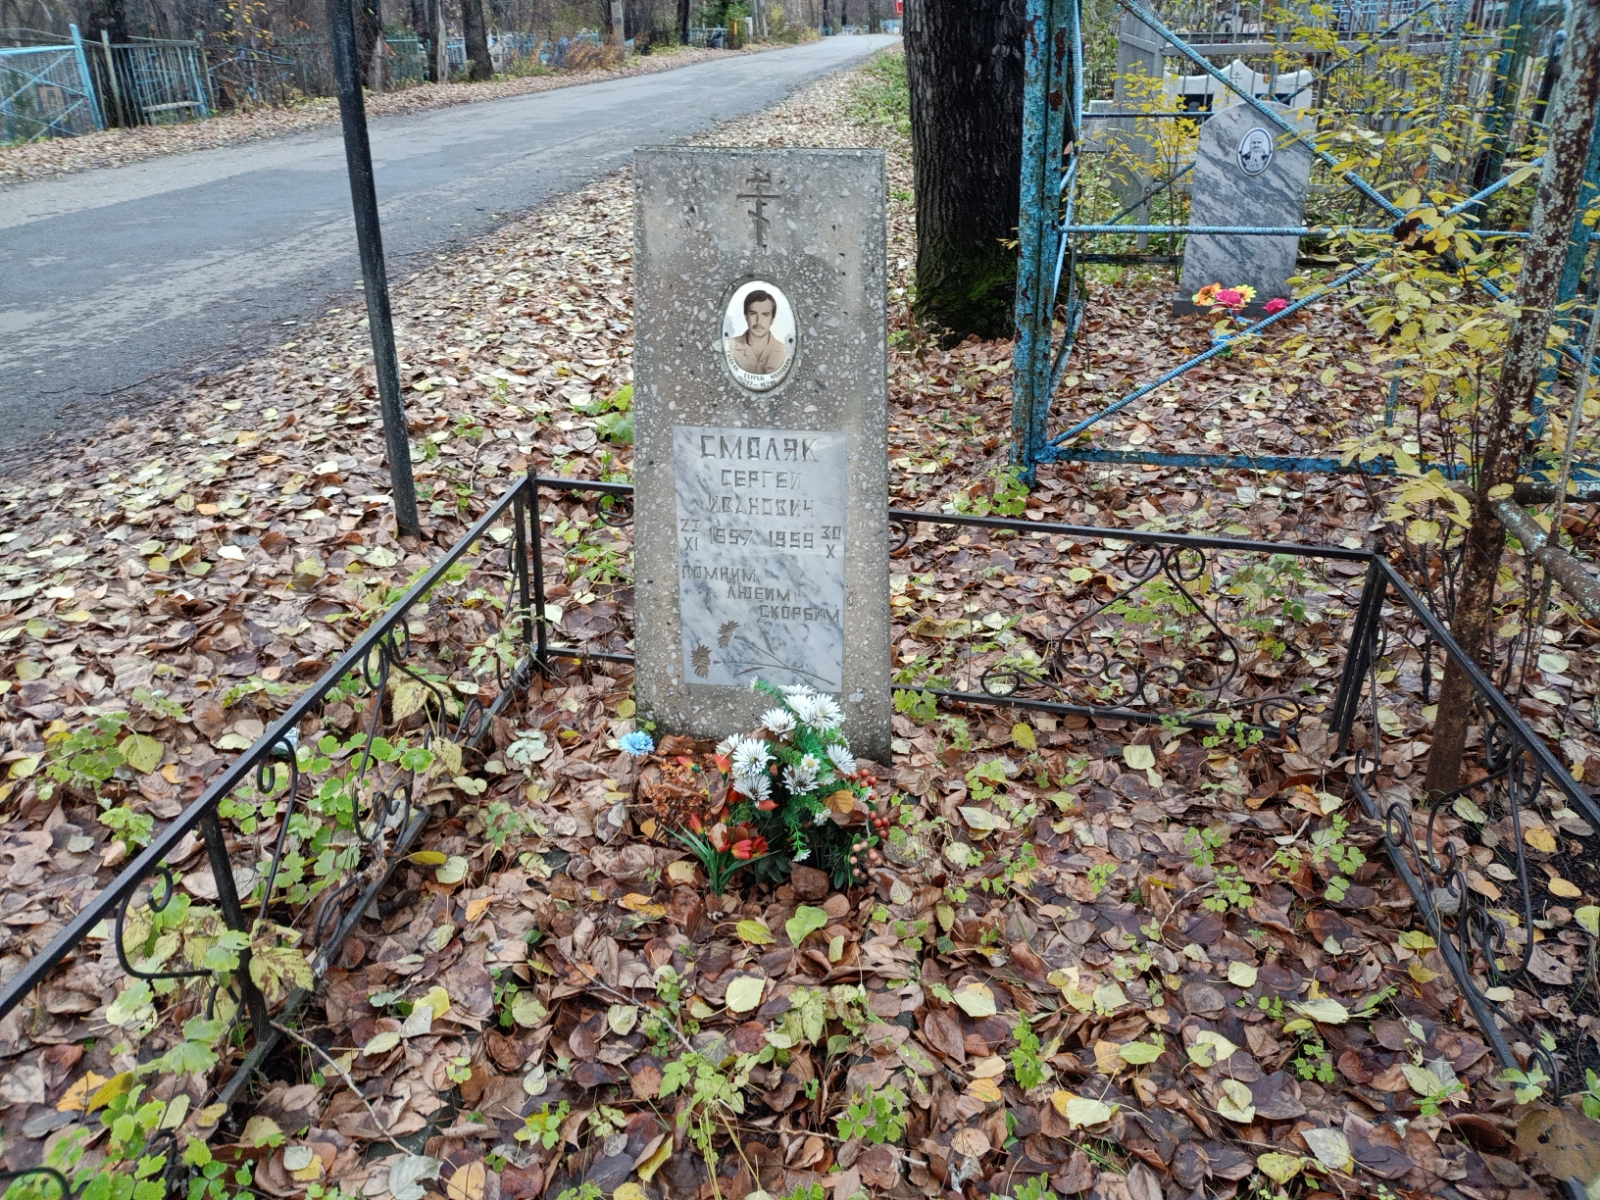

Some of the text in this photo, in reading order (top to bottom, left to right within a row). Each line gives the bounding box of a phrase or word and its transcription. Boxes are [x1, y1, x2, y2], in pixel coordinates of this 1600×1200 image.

[700, 435, 819, 462] СМОЛЯК
[709, 527, 753, 546] 1957
[821, 525, 842, 540] 30
[682, 565, 757, 583] ПОМНИМ
[727, 586, 791, 602] ЛЮБИМ
[759, 604, 840, 623] СКОРБИМ
